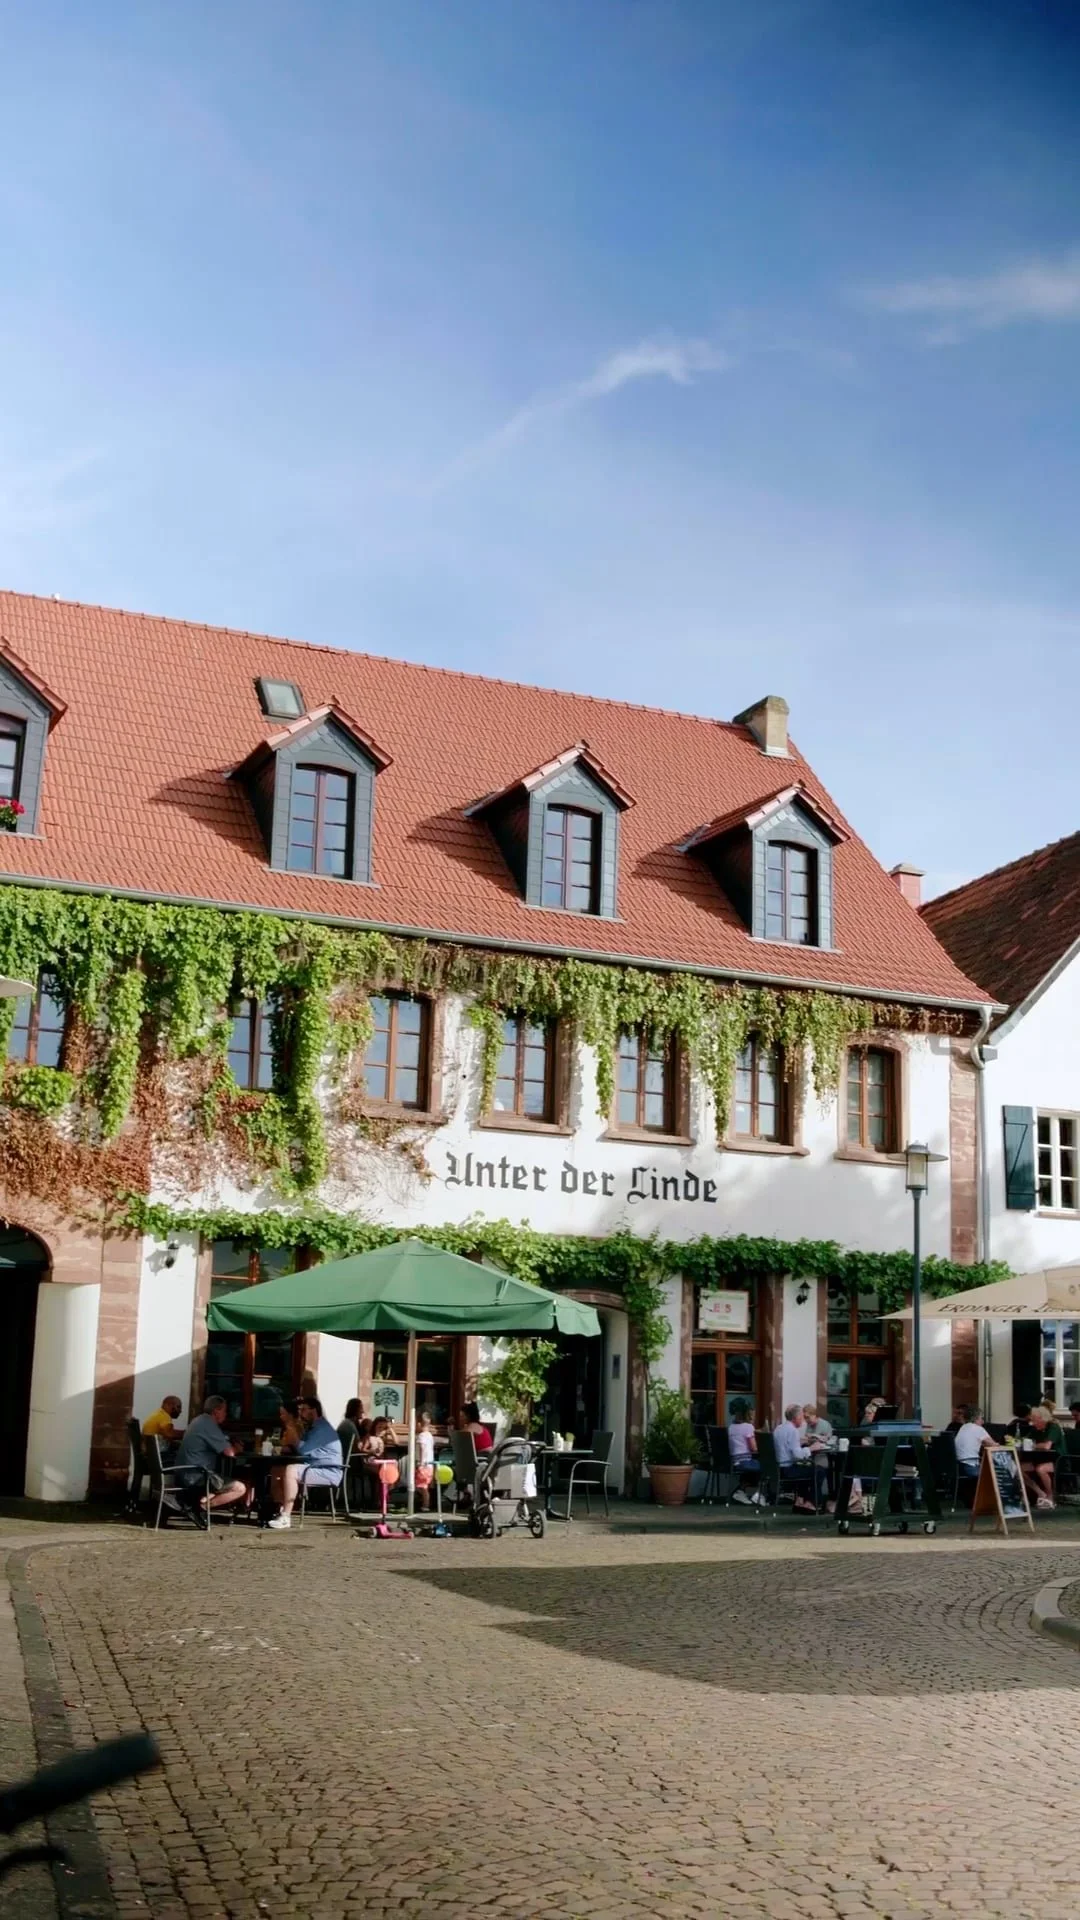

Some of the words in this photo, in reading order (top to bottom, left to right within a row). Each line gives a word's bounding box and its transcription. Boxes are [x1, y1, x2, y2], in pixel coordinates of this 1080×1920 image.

[445, 1151, 548, 1192] Unter
[560, 1160, 615, 1197] der
[627, 1166, 718, 1204] Linde
[938, 1303, 1027, 1314] ERDINGER
